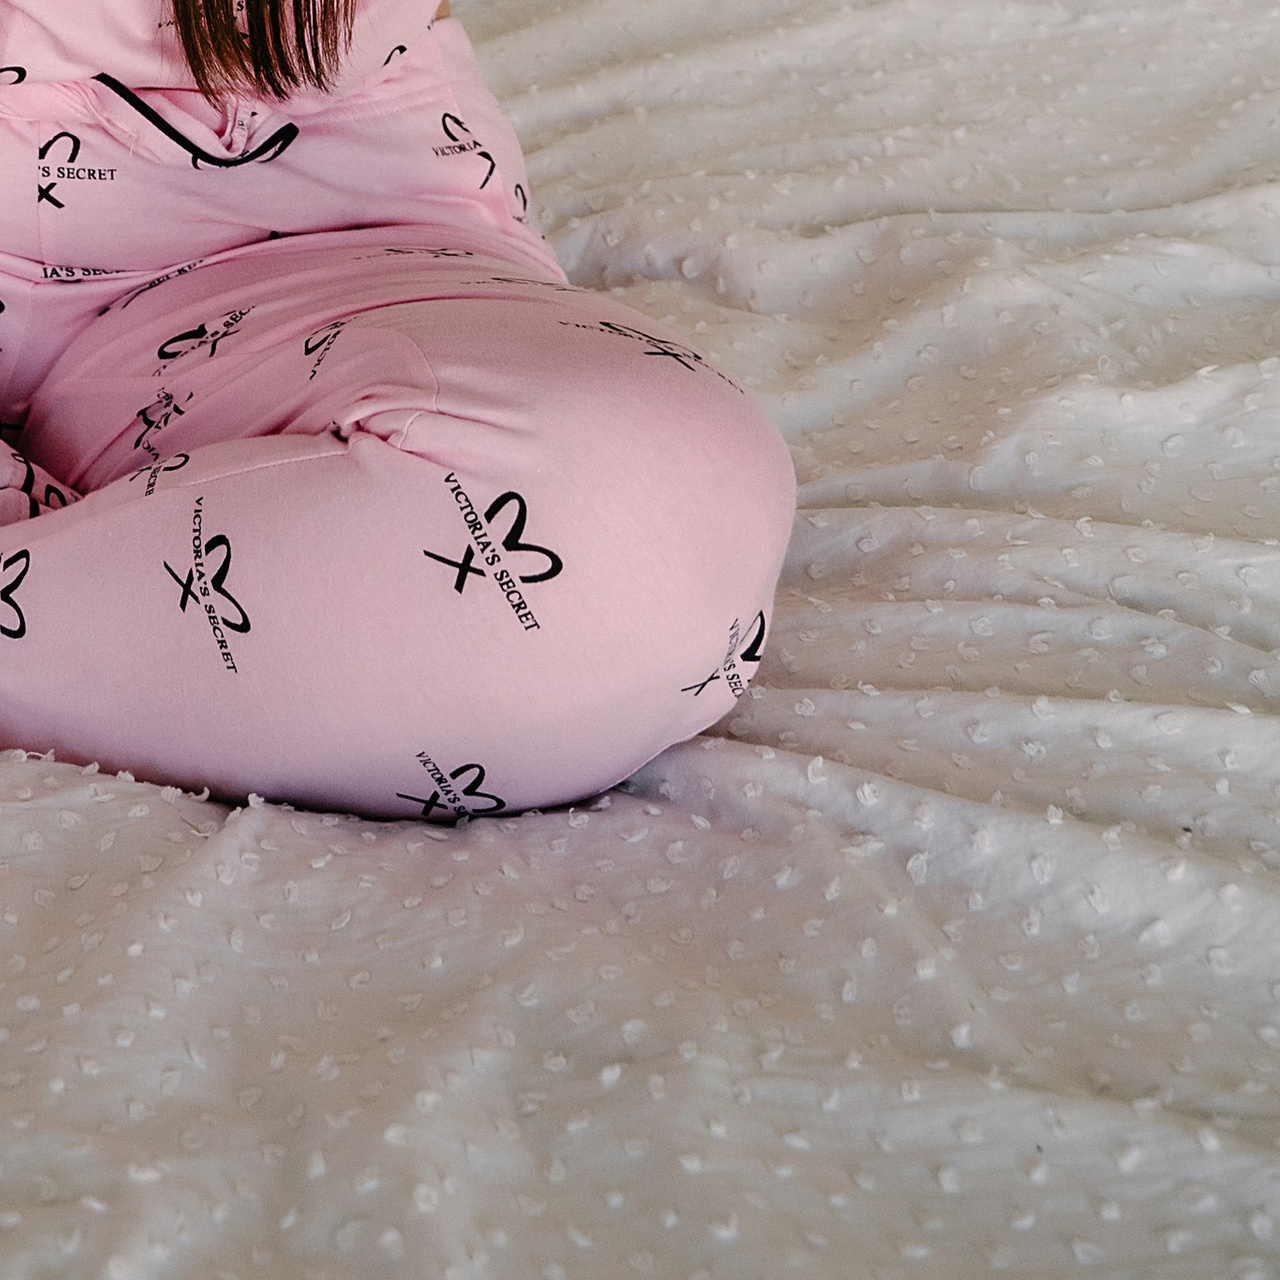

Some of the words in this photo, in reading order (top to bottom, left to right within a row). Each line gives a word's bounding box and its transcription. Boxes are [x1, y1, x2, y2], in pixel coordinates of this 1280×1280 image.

[56, 166, 117, 181] SECRET
[192, 496, 210, 598] VICTORIA'S
[204, 603, 238, 674] SECRET
[444, 472, 501, 567] VICTORIA'S
[493, 569, 541, 631] SECRET
[416, 751, 461, 804] VICTORIA'S
